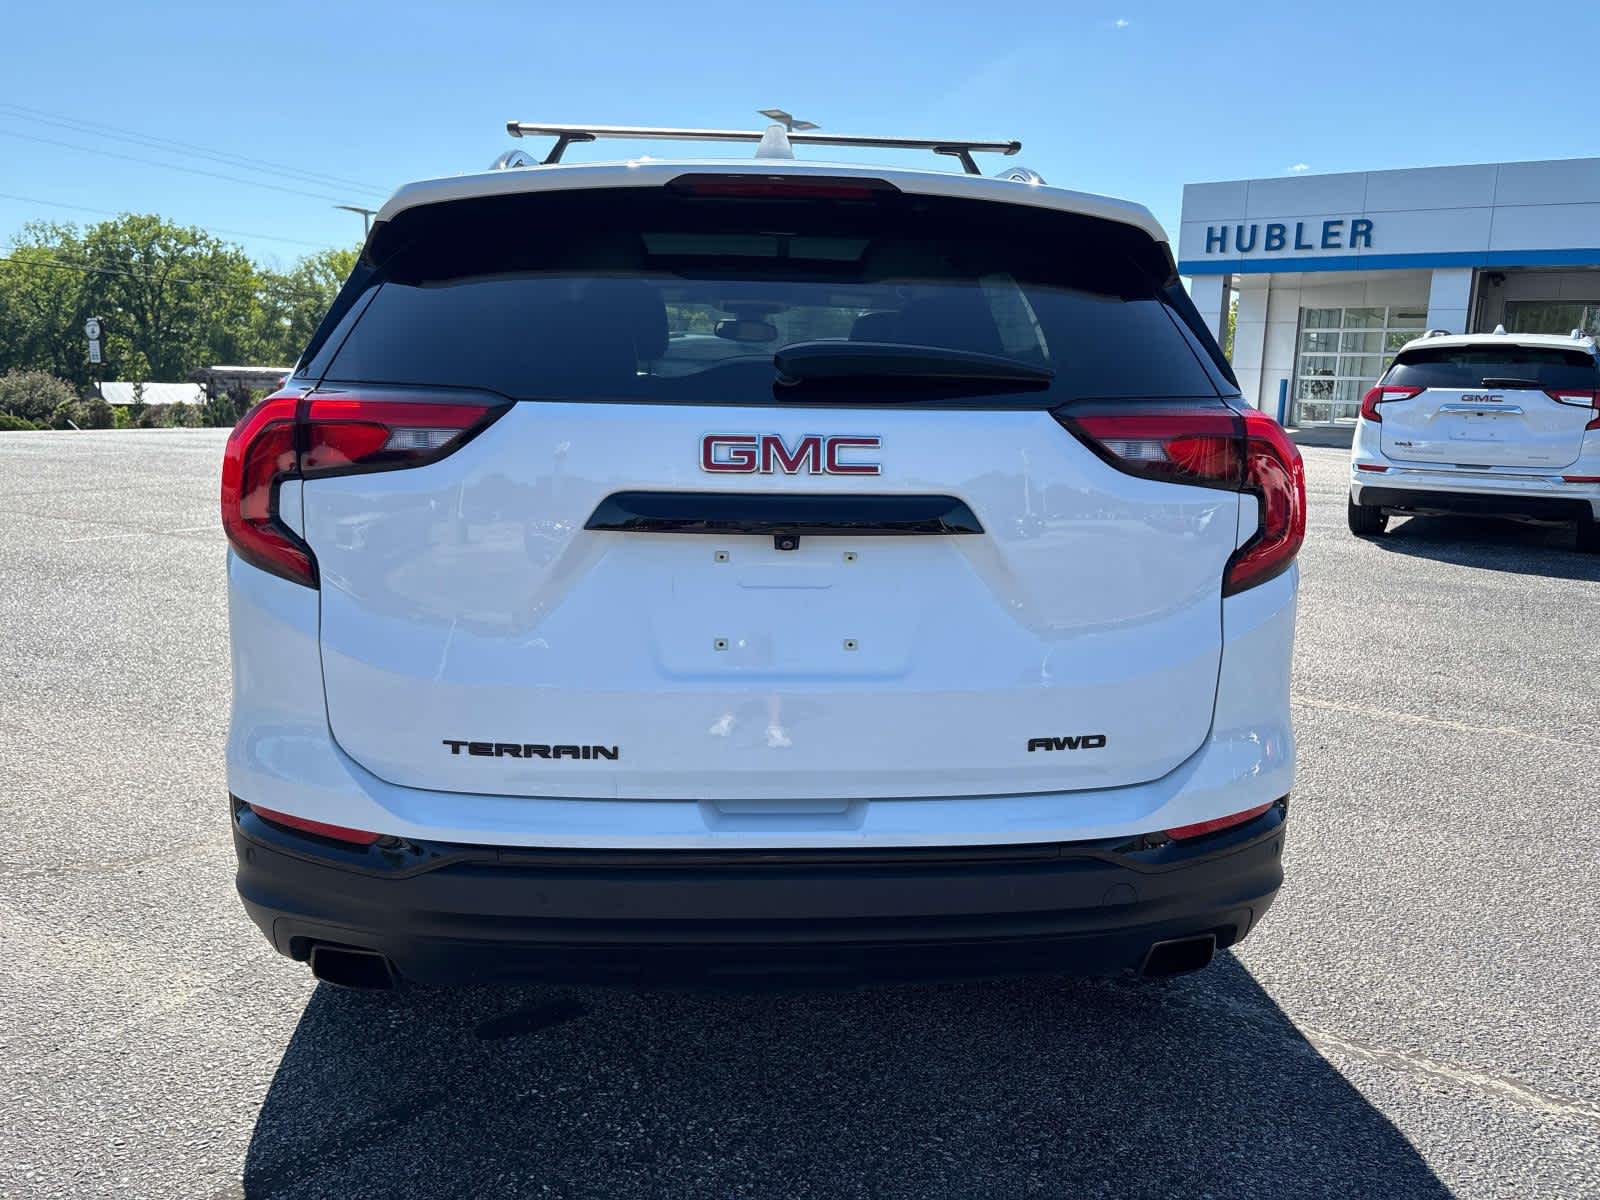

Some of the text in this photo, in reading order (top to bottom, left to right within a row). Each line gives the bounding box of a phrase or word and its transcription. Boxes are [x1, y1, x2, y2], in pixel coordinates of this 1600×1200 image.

[1205, 219, 1374, 253] HUBLER
[1461, 394, 1504, 403] GMC
[700, 432, 882, 476] GMC
[442, 739, 619, 760] TERRAIN
[1027, 734, 1106, 752] AWD
